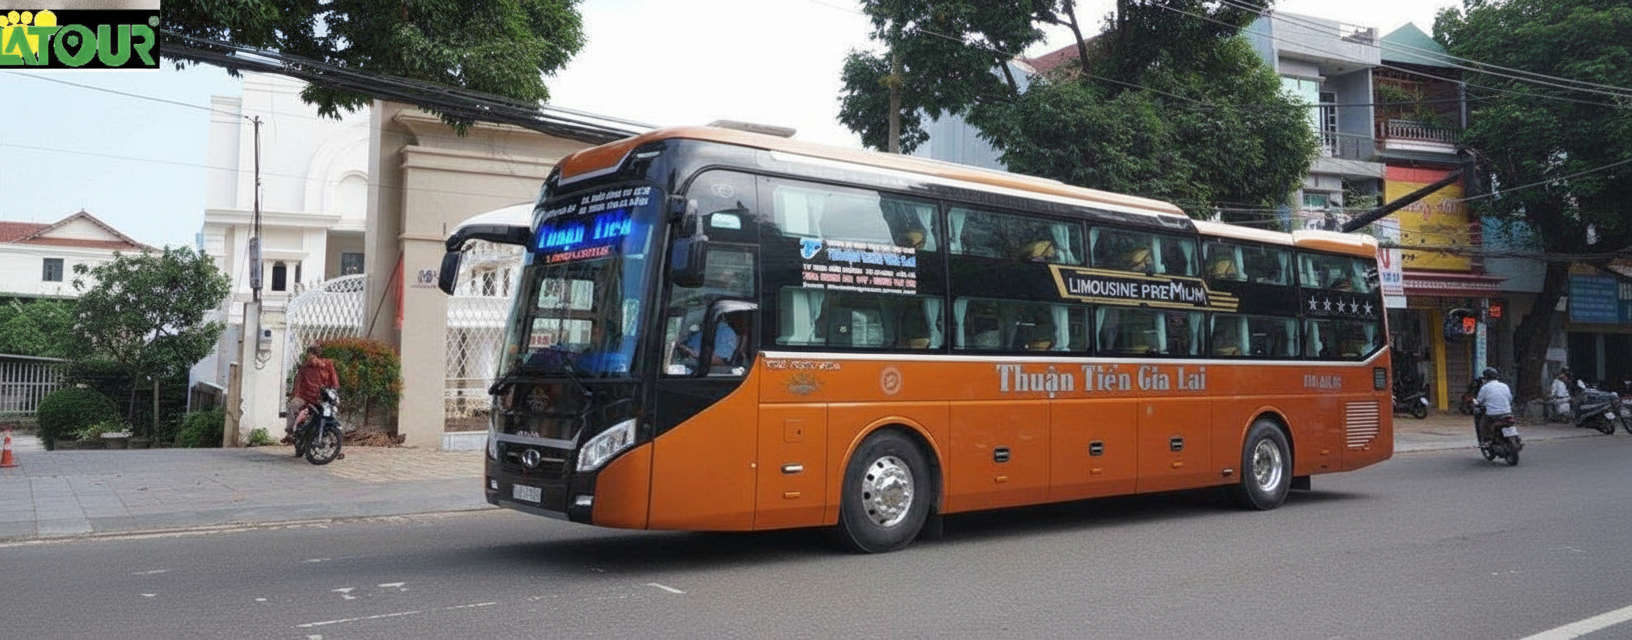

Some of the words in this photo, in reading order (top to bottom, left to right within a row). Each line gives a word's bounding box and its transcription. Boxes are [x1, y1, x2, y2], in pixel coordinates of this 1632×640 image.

[1069, 277, 1139, 298] LIMOUSINE
[996, 364, 1074, 398] Thuận
[1081, 363, 1131, 391] Tiến
[1137, 365, 1170, 390] Gia
[1177, 366, 1206, 390] Lai
